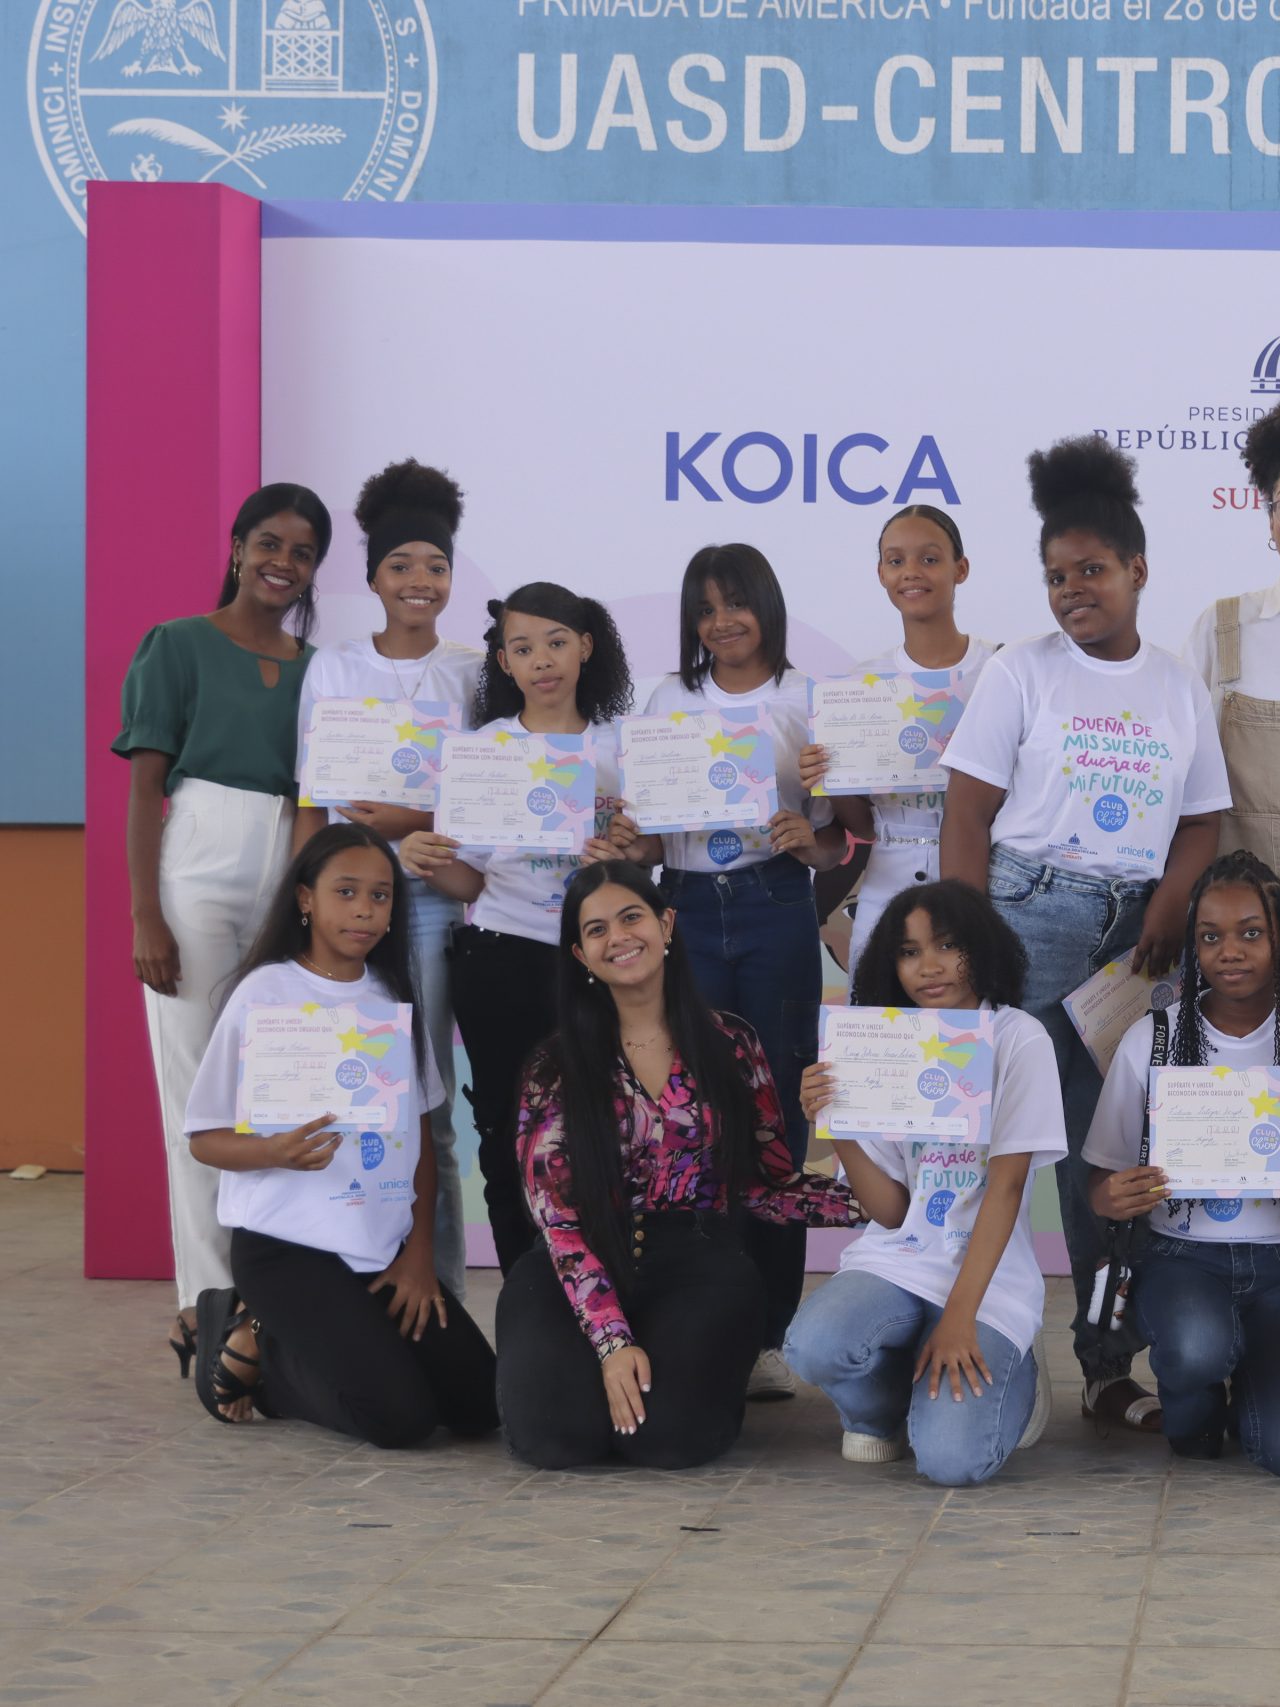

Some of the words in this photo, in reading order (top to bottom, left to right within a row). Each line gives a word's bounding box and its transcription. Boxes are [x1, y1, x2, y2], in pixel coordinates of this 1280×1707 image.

[699, 0, 748, 18] DE
[1216, 0, 1257, 21] de
[43, 87, 90, 198] OMINICI
[1093, 424, 1249, 451] EPÚBLIC
[665, 431, 962, 505] KOICA
[1072, 716, 1126, 737] DUEÑA
[1132, 723, 1153, 738] DE
[1102, 737, 1173, 761] SUEÑOS,
[1076, 750, 1131, 773] dueña
[1132, 760, 1151, 774] de
[1089, 773, 1164, 806] FUTURO
[1100, 800, 1123, 811] CLUB
[713, 837, 737, 845] CLUB
[1116, 845, 1145, 858] unicef
[1151, 1024, 1166, 1067] FOREVE
[1255, 1128, 1277, 1136] CLUB
[378, 1178, 409, 1190] unice
